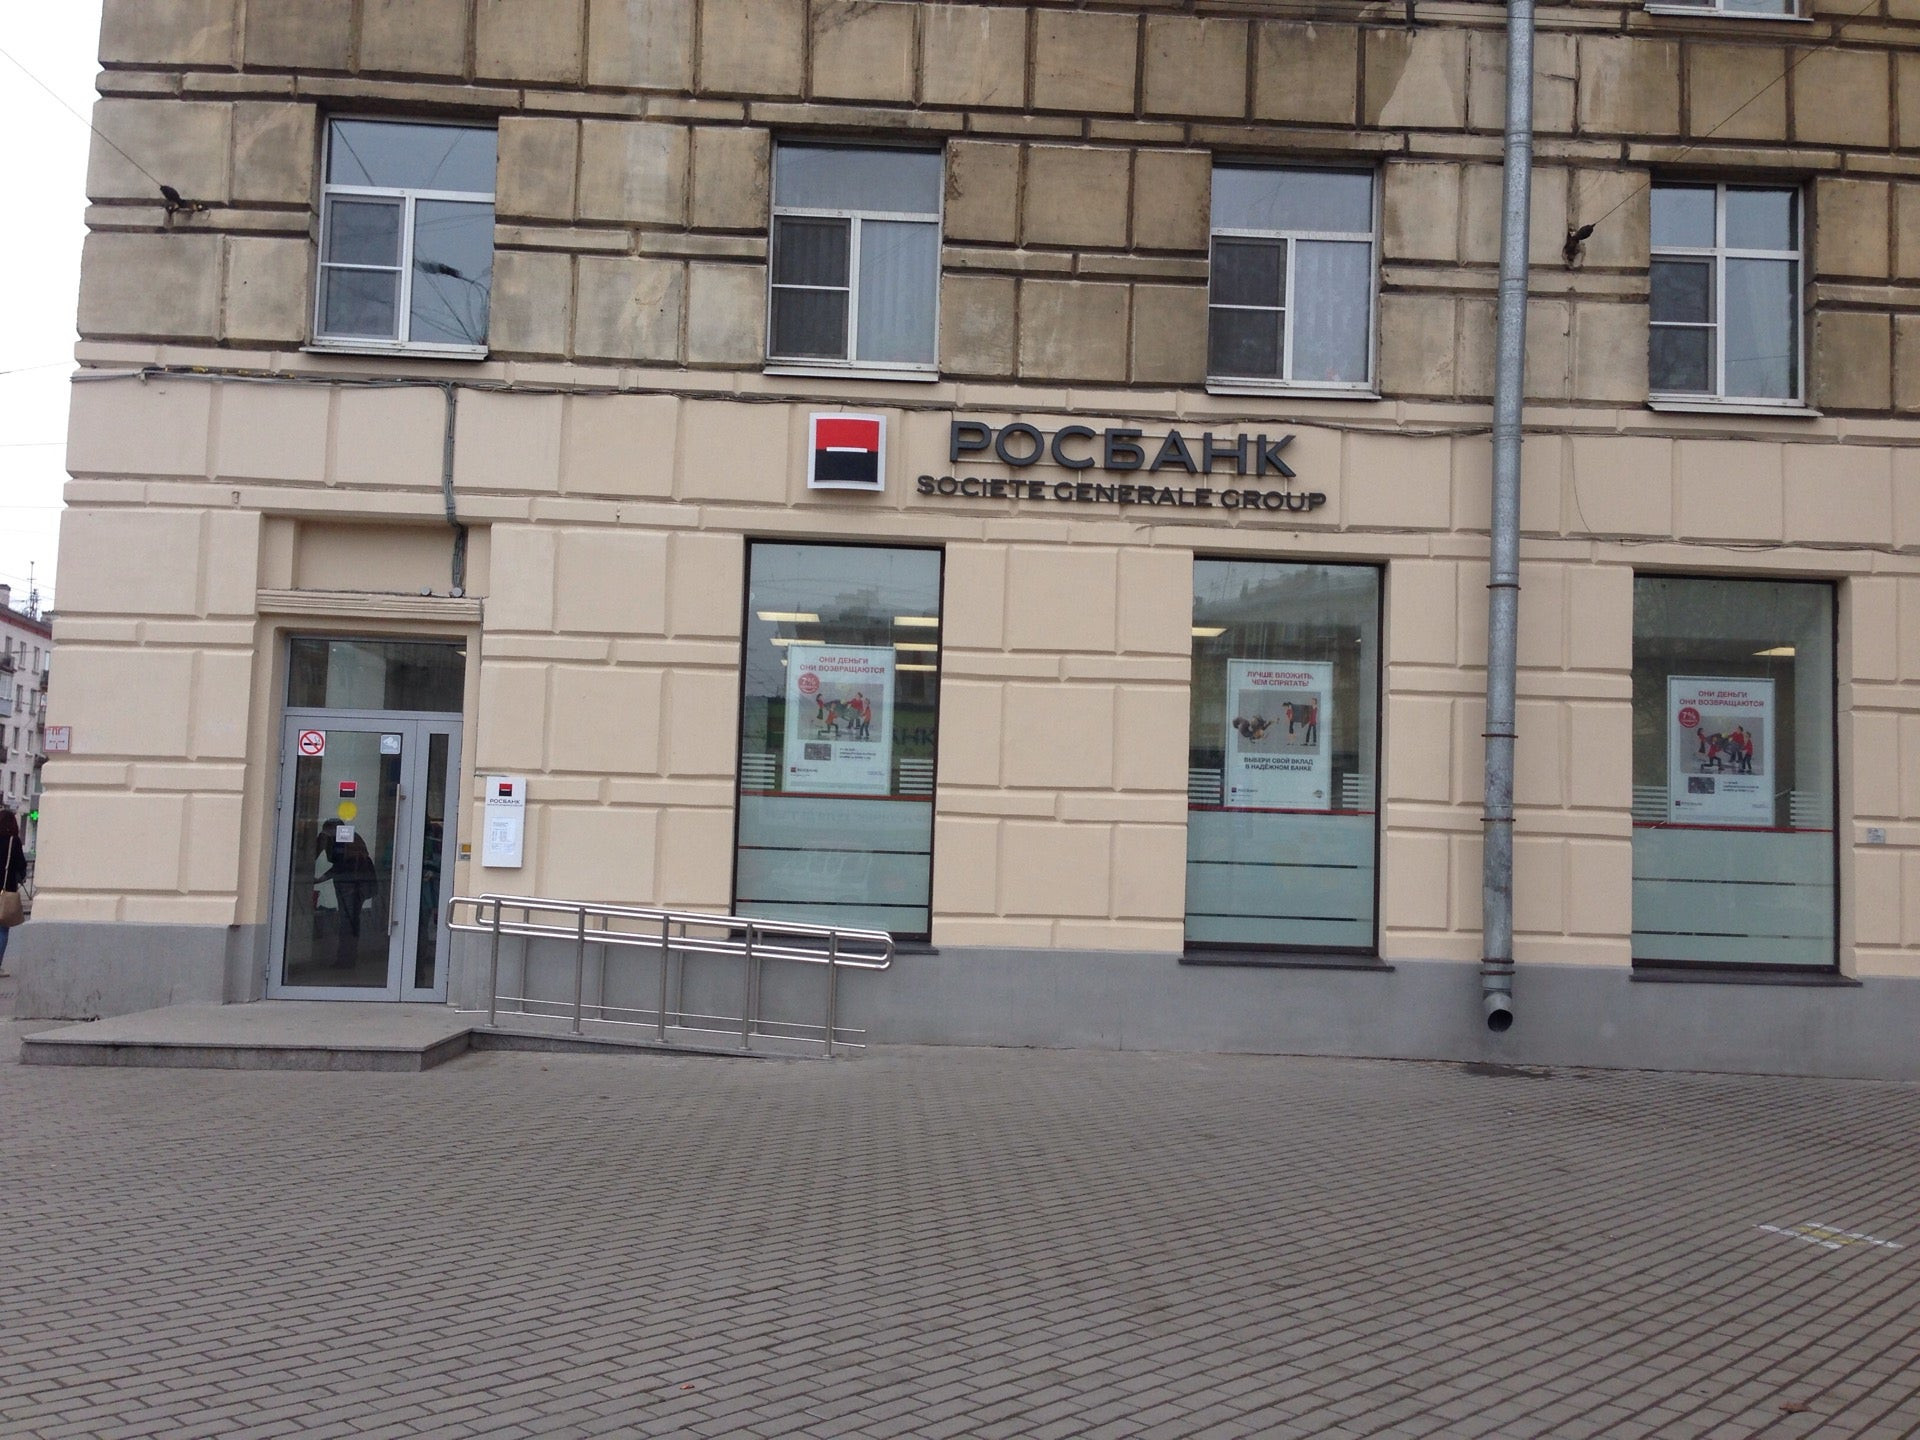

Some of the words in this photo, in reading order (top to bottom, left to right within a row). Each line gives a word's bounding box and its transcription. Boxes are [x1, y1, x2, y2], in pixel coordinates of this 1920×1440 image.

[950, 420, 1297, 478] РОСБАНК
[916, 474, 1046, 499] SOCIETE
[1053, 481, 1213, 507] GENERALE
[1220, 488, 1327, 511] GROUP
[819, 656, 836, 664] ОНИ
[837, 657, 869, 665] ДЕНЬГИ
[800, 664, 816, 672] ОНИ
[818, 665, 885, 674] ВОЗВРАЩАЮТСЯ
[1679, 698, 1697, 706] ОНИ
[1697, 699, 1765, 708] ВОЗВРАЩАЮТСЯ
[1244, 756, 1271, 764] ВЫБЕРИ
[1291, 758, 1314, 766] ВКЛАД
